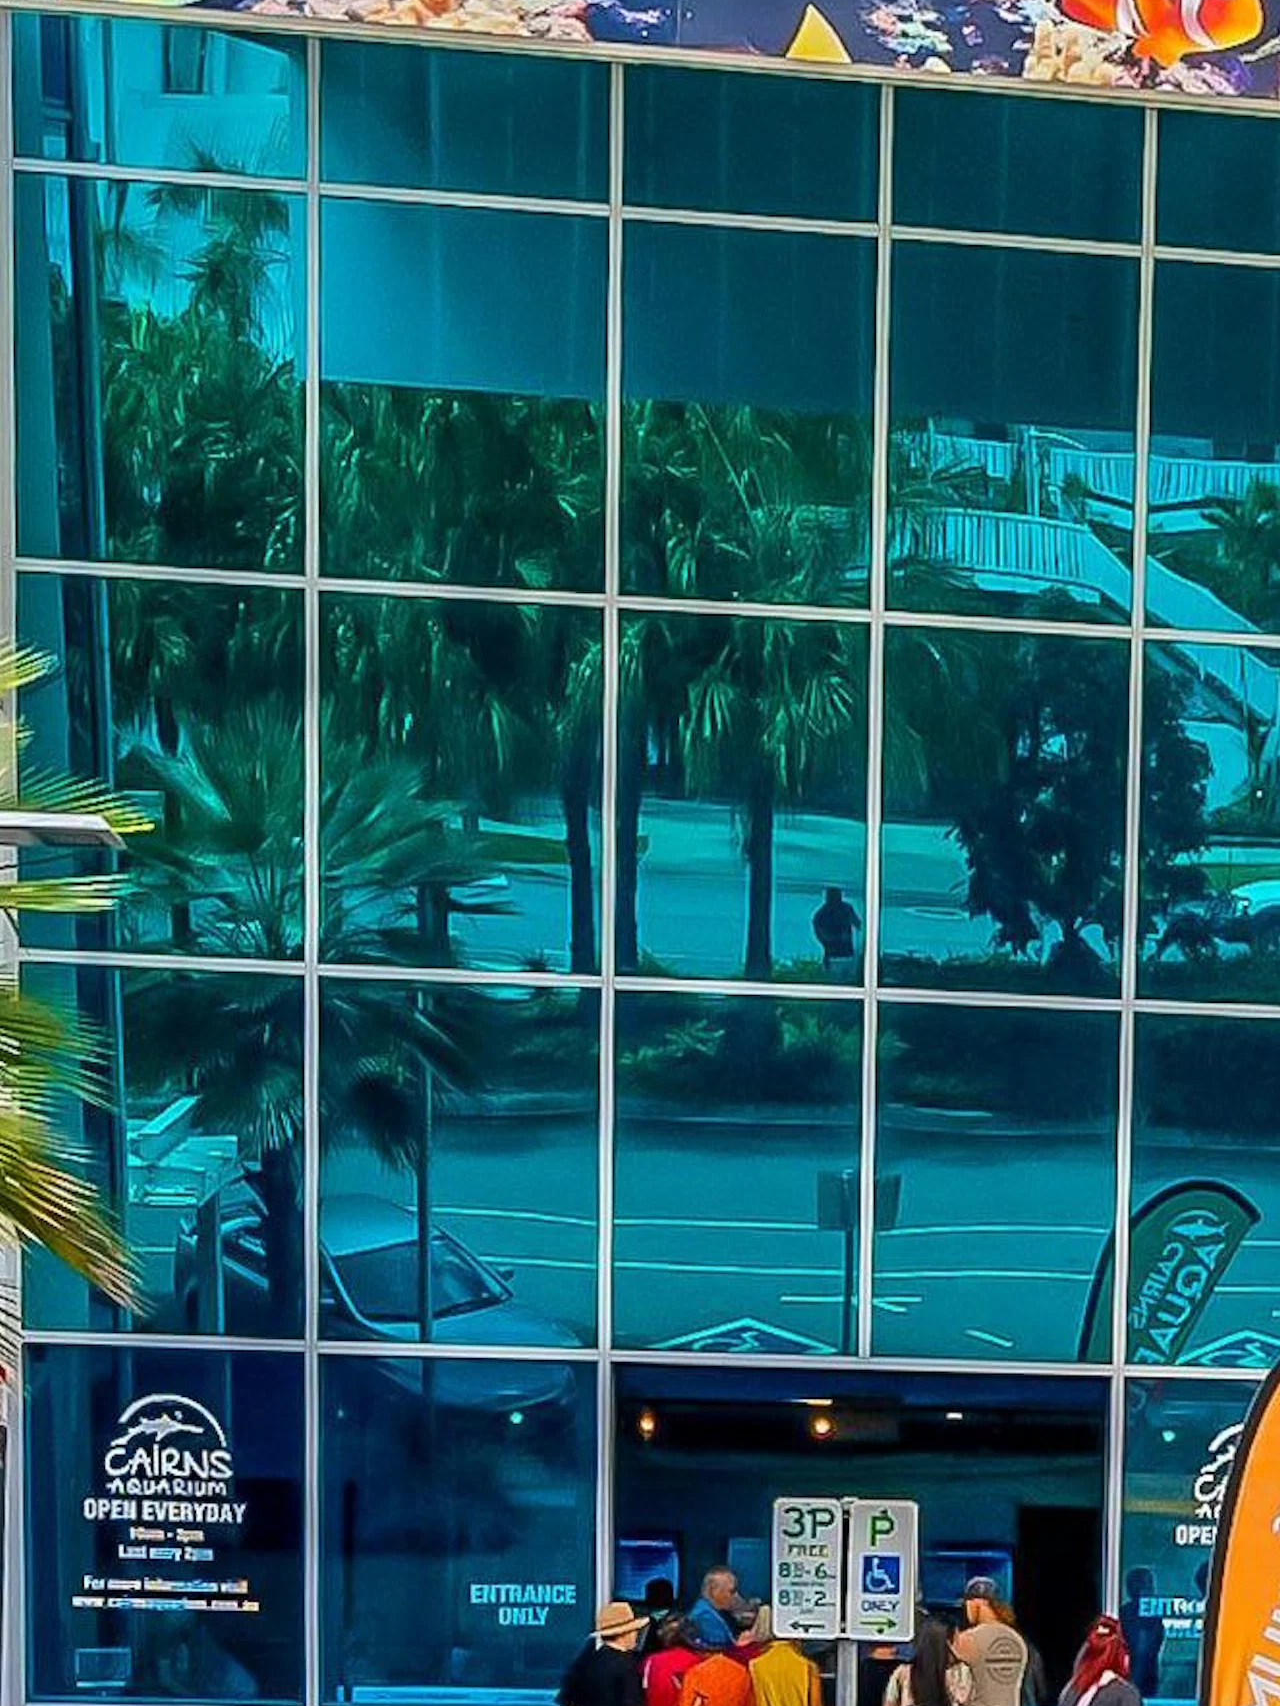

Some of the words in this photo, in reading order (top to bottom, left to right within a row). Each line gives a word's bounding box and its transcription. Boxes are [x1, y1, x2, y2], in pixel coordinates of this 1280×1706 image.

[105, 1478, 228, 1497] AQUARIUM
[83, 1497, 137, 1521] OPEN
[142, 1500, 247, 1524] EVERYDAY
[782, 1506, 836, 1539] 3P
[870, 1515, 895, 1547] P
[469, 1583, 577, 1605] ENTRANCE
[499, 1606, 550, 1626] ONLY
